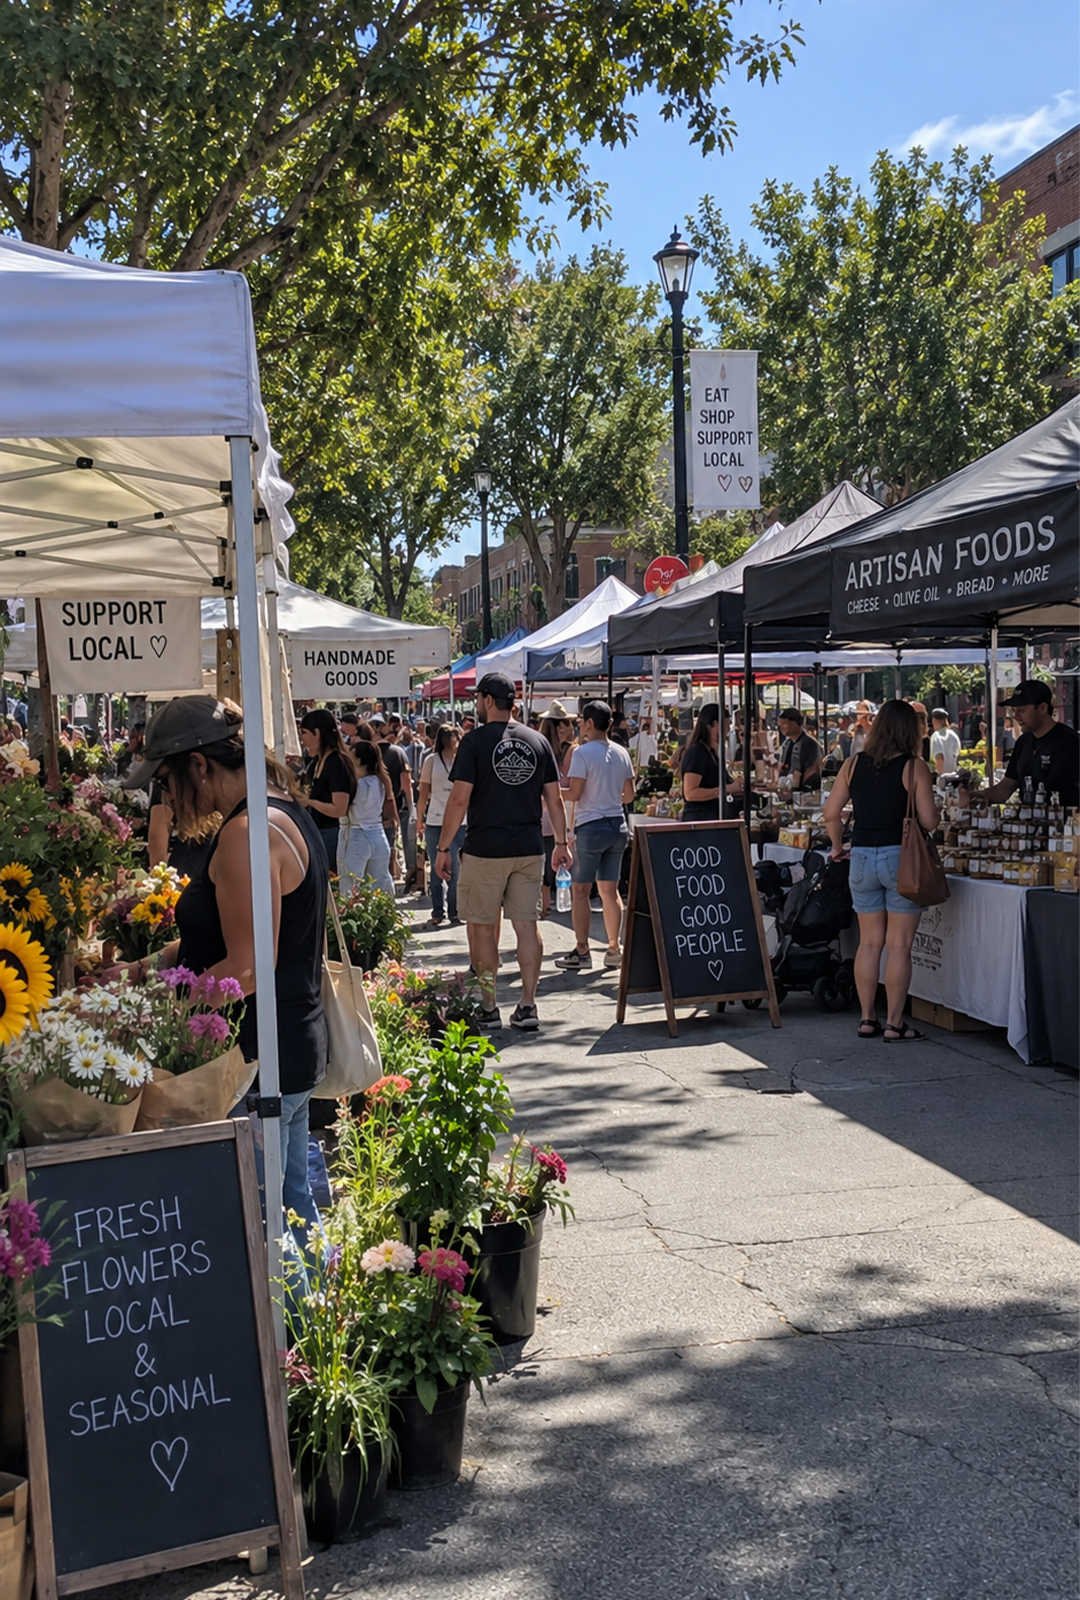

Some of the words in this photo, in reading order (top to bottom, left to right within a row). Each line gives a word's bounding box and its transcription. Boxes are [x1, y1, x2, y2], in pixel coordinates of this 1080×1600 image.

[705, 388, 729, 402] EAT
[700, 409, 735, 424] SHOP
[697, 431, 753, 445] SUPPORT
[704, 452, 744, 467] LOCAL
[844, 542, 944, 591] ARTISAN
[954, 515, 1056, 570] FOODS
[847, 596, 880, 615] CHEESE
[893, 589, 921, 607] OLIVE
[923, 586, 940, 602] OIL
[956, 575, 995, 597] BREAD
[1012, 564, 1051, 587] MORE
[62, 600, 167, 626] SUPPORT
[69, 636, 143, 661] LOCAL
[304, 650, 396, 666] HANDMADE
[325, 671, 378, 686] GOODS
[669, 845, 722, 870] GOOD
[675, 874, 725, 898] FOOD
[680, 903, 732, 928] GOOD
[675, 929, 747, 957] PEOPLE
[74, 1196, 182, 1248] FRESH
[62, 1240, 211, 1299] FLOWERS
[84, 1294, 190, 1344] LOCAL
[134, 1342, 157, 1378] &
[69, 1373, 231, 1437] SEASONAL
